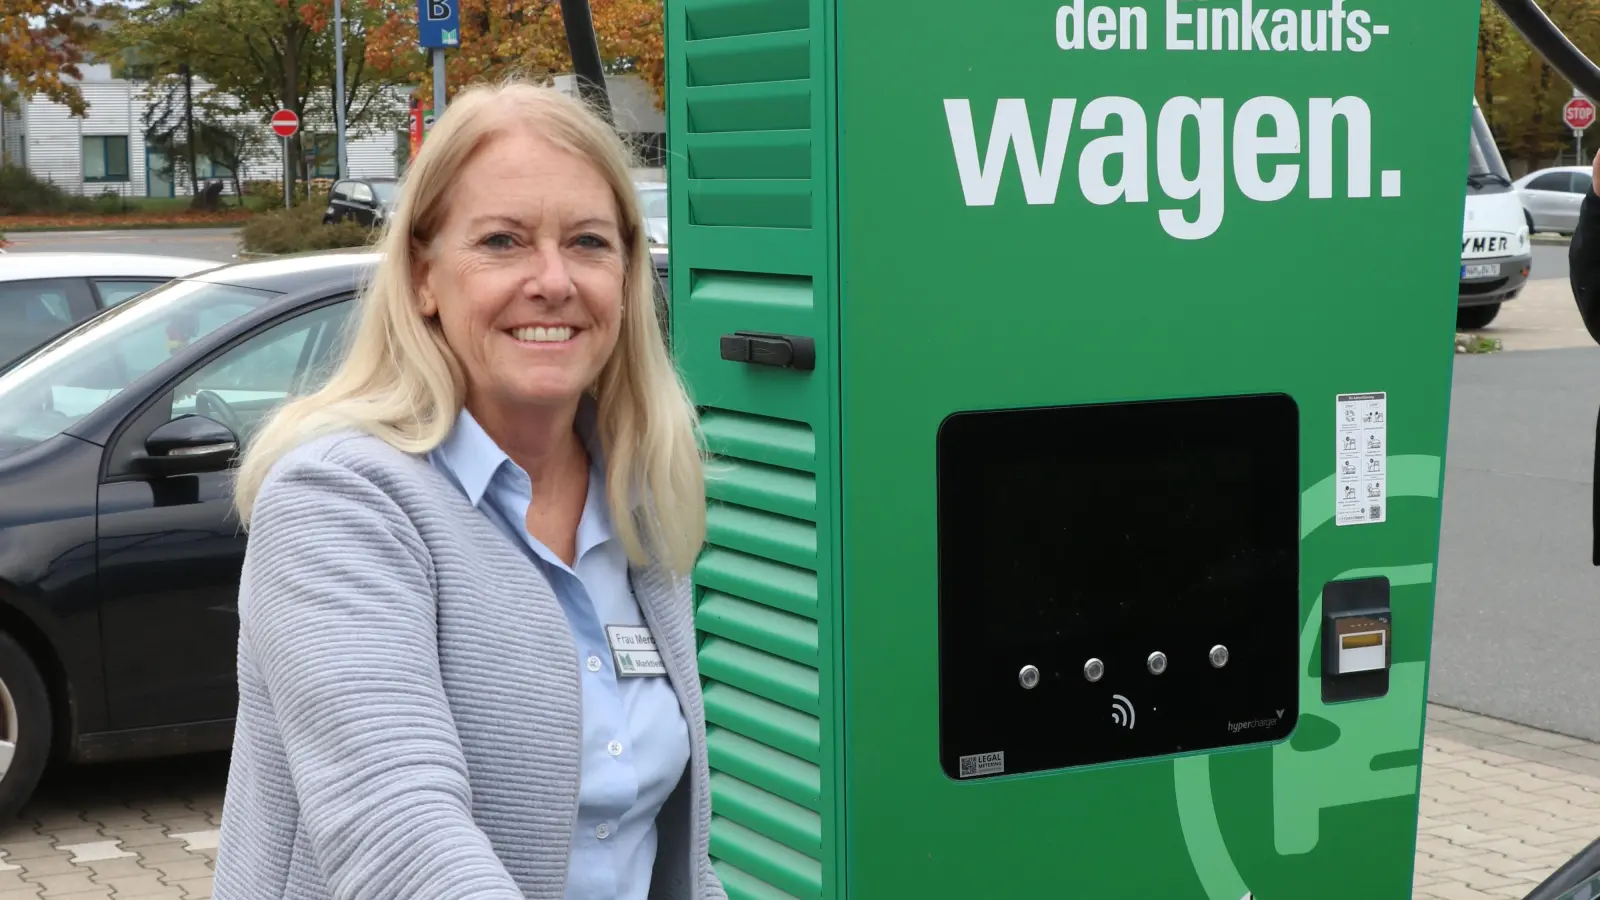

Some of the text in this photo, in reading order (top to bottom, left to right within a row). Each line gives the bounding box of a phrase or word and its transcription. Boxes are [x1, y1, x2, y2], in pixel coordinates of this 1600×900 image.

[427, 0, 451, 21] B
[1055, 0, 1390, 52] den Einkaufs-
[1567, 107, 1593, 120] STOP
[942, 95, 1402, 241] wagen.
[615, 633, 635, 645] Frau
[1227, 717, 1278, 733] hypercharger
[978, 753, 1002, 764] LEGAL
